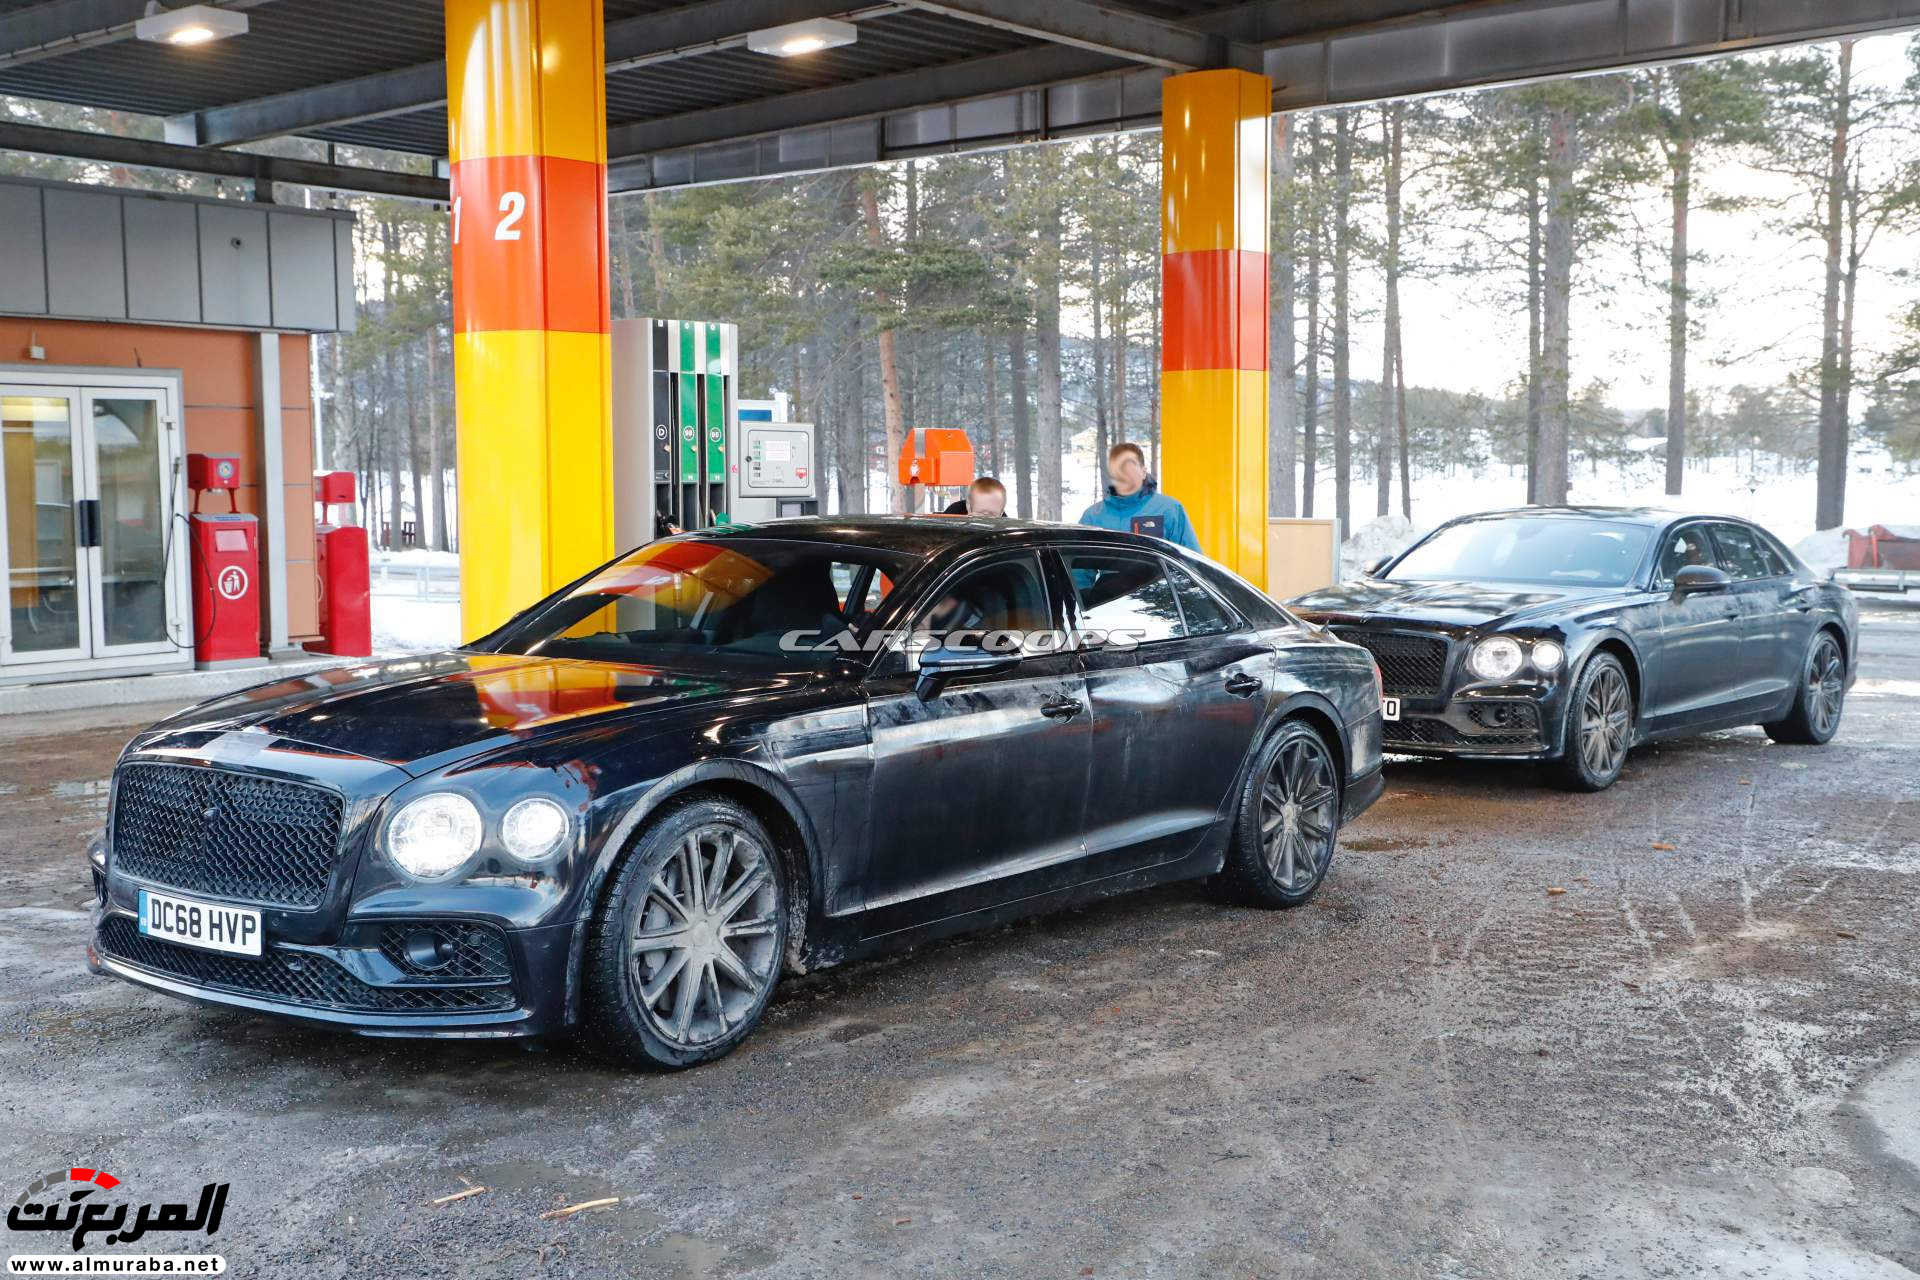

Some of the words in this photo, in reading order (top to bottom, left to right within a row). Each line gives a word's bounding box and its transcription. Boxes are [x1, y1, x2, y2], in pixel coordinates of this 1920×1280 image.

[453, 196, 461, 244] 1
[494, 191, 525, 240] 2
[658, 428, 665, 436] D
[151, 898, 201, 938] DC68
[209, 910, 256, 945] HVP
